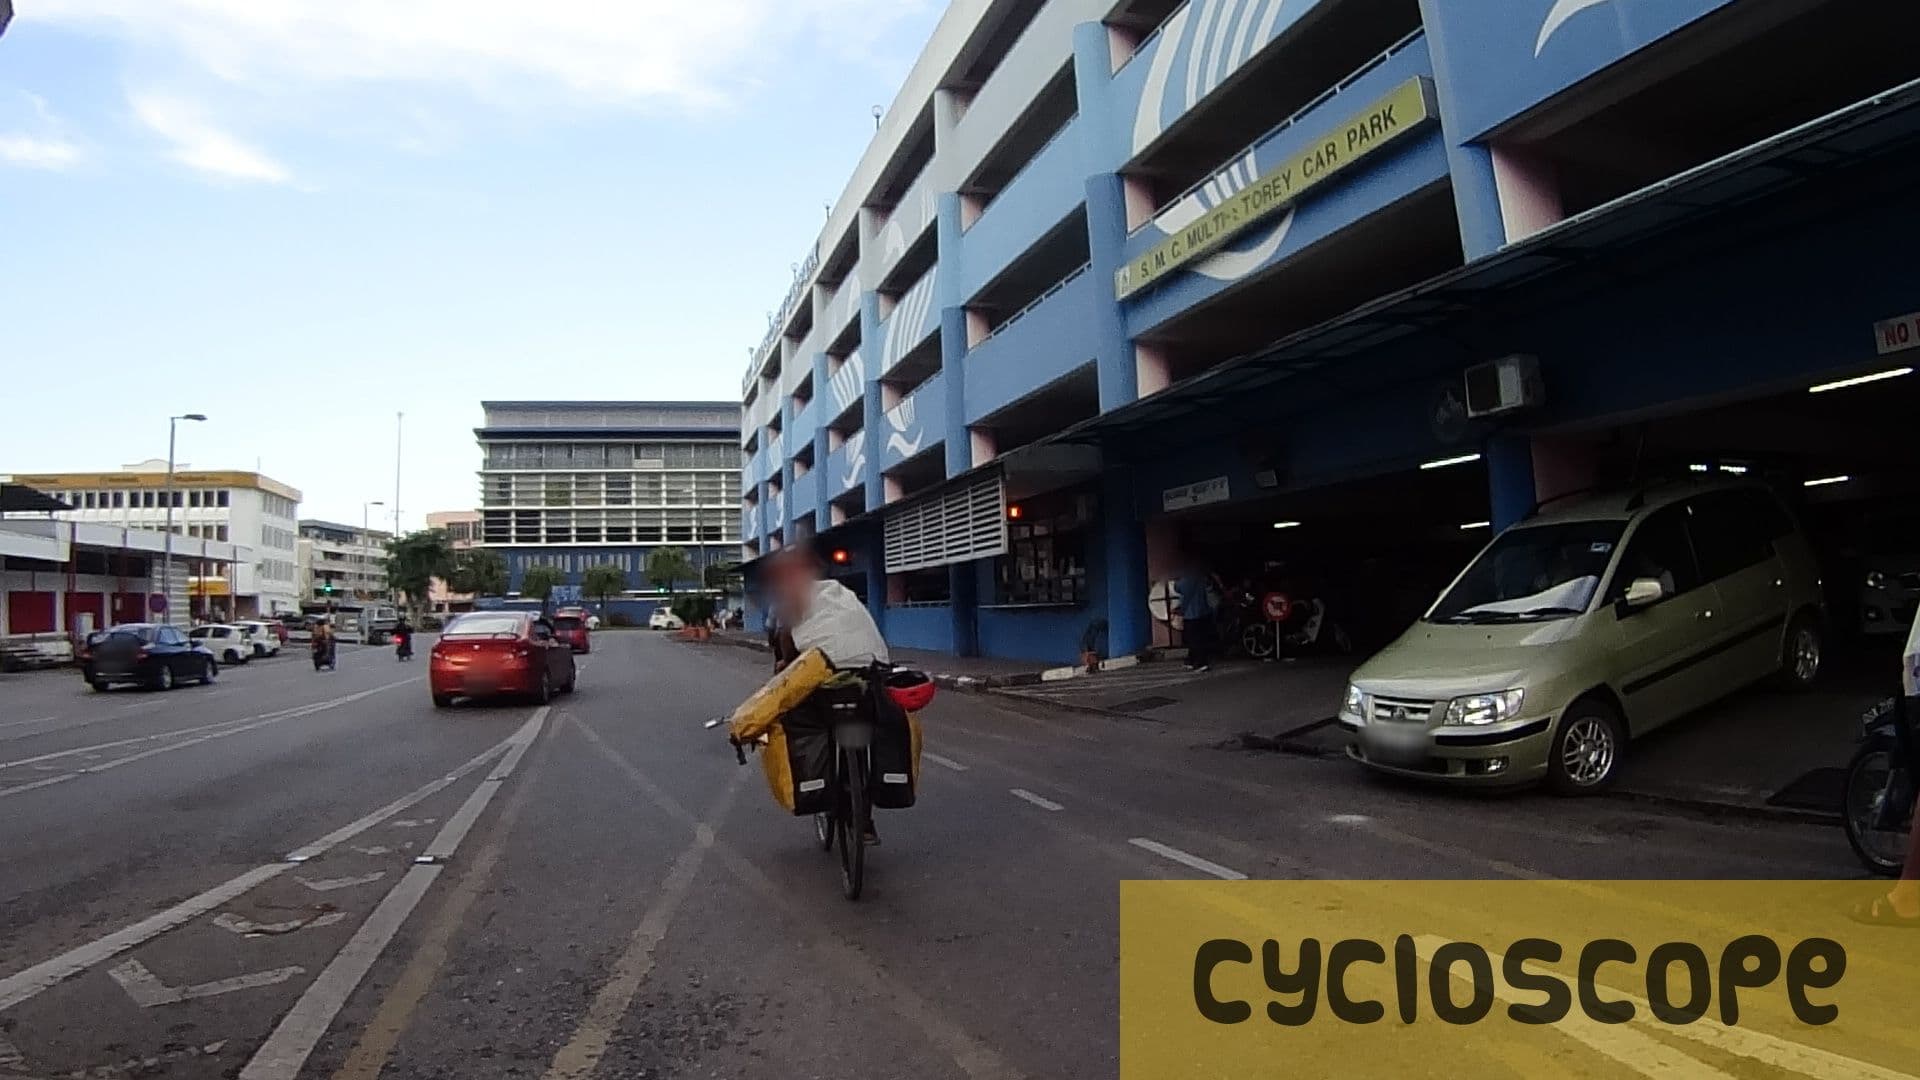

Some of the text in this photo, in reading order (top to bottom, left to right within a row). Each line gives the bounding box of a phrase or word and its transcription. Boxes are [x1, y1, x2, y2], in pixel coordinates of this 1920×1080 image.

[1302, 142, 1338, 183] CAR
[1346, 103, 1397, 153] PARK
[1885, 322, 1909, 346] NO
